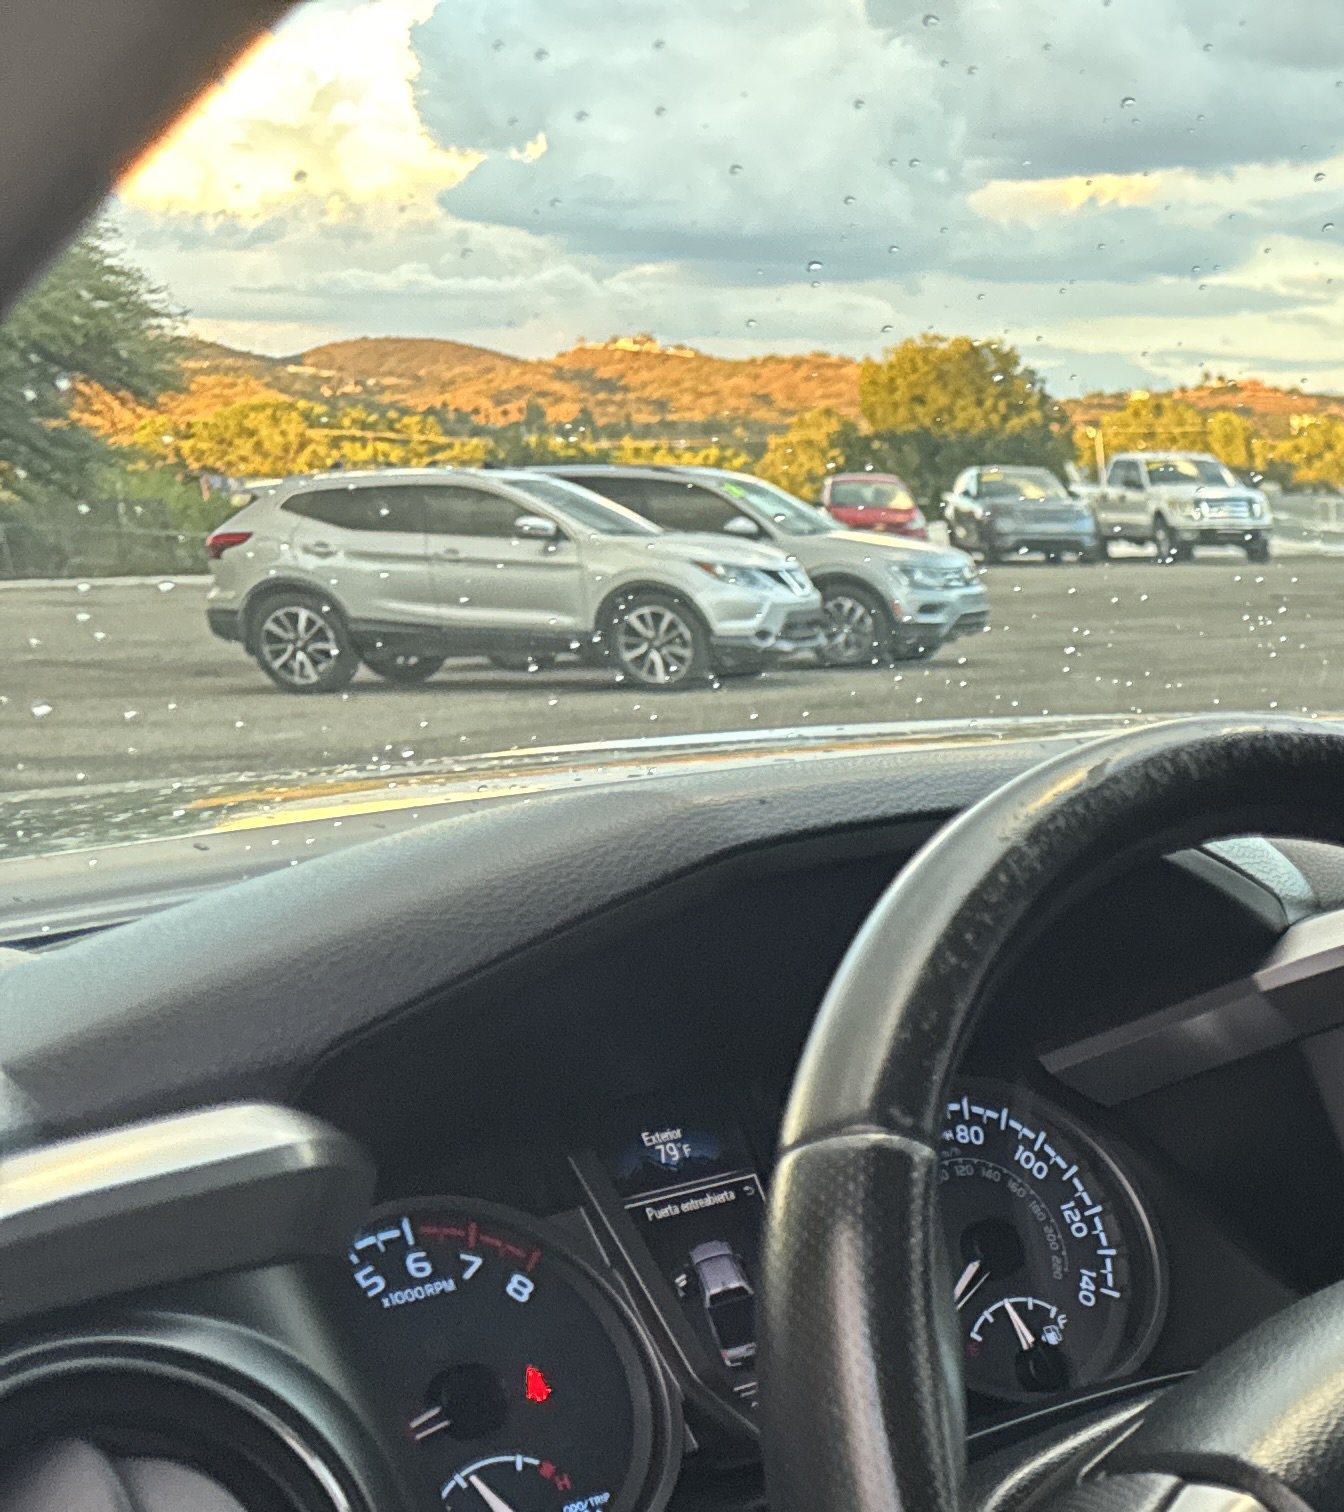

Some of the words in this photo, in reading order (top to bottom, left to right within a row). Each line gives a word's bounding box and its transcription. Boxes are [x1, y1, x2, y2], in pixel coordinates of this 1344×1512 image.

[641, 1128, 682, 1147] Exterior
[955, 1124, 985, 1145] 80
[1014, 1144, 1049, 1179] 100
[645, 1204, 680, 1221] Puerta
[681, 1190, 736, 1213] entreabierta
[1060, 1201, 1088, 1238] 120
[405, 1251, 433, 1279] 6
[459, 1253, 484, 1280] 7
[354, 1264, 387, 1298] 5
[505, 1273, 535, 1303] 8
[1077, 1269, 1098, 1308] 140
[1057, 1313, 1068, 1330] F
